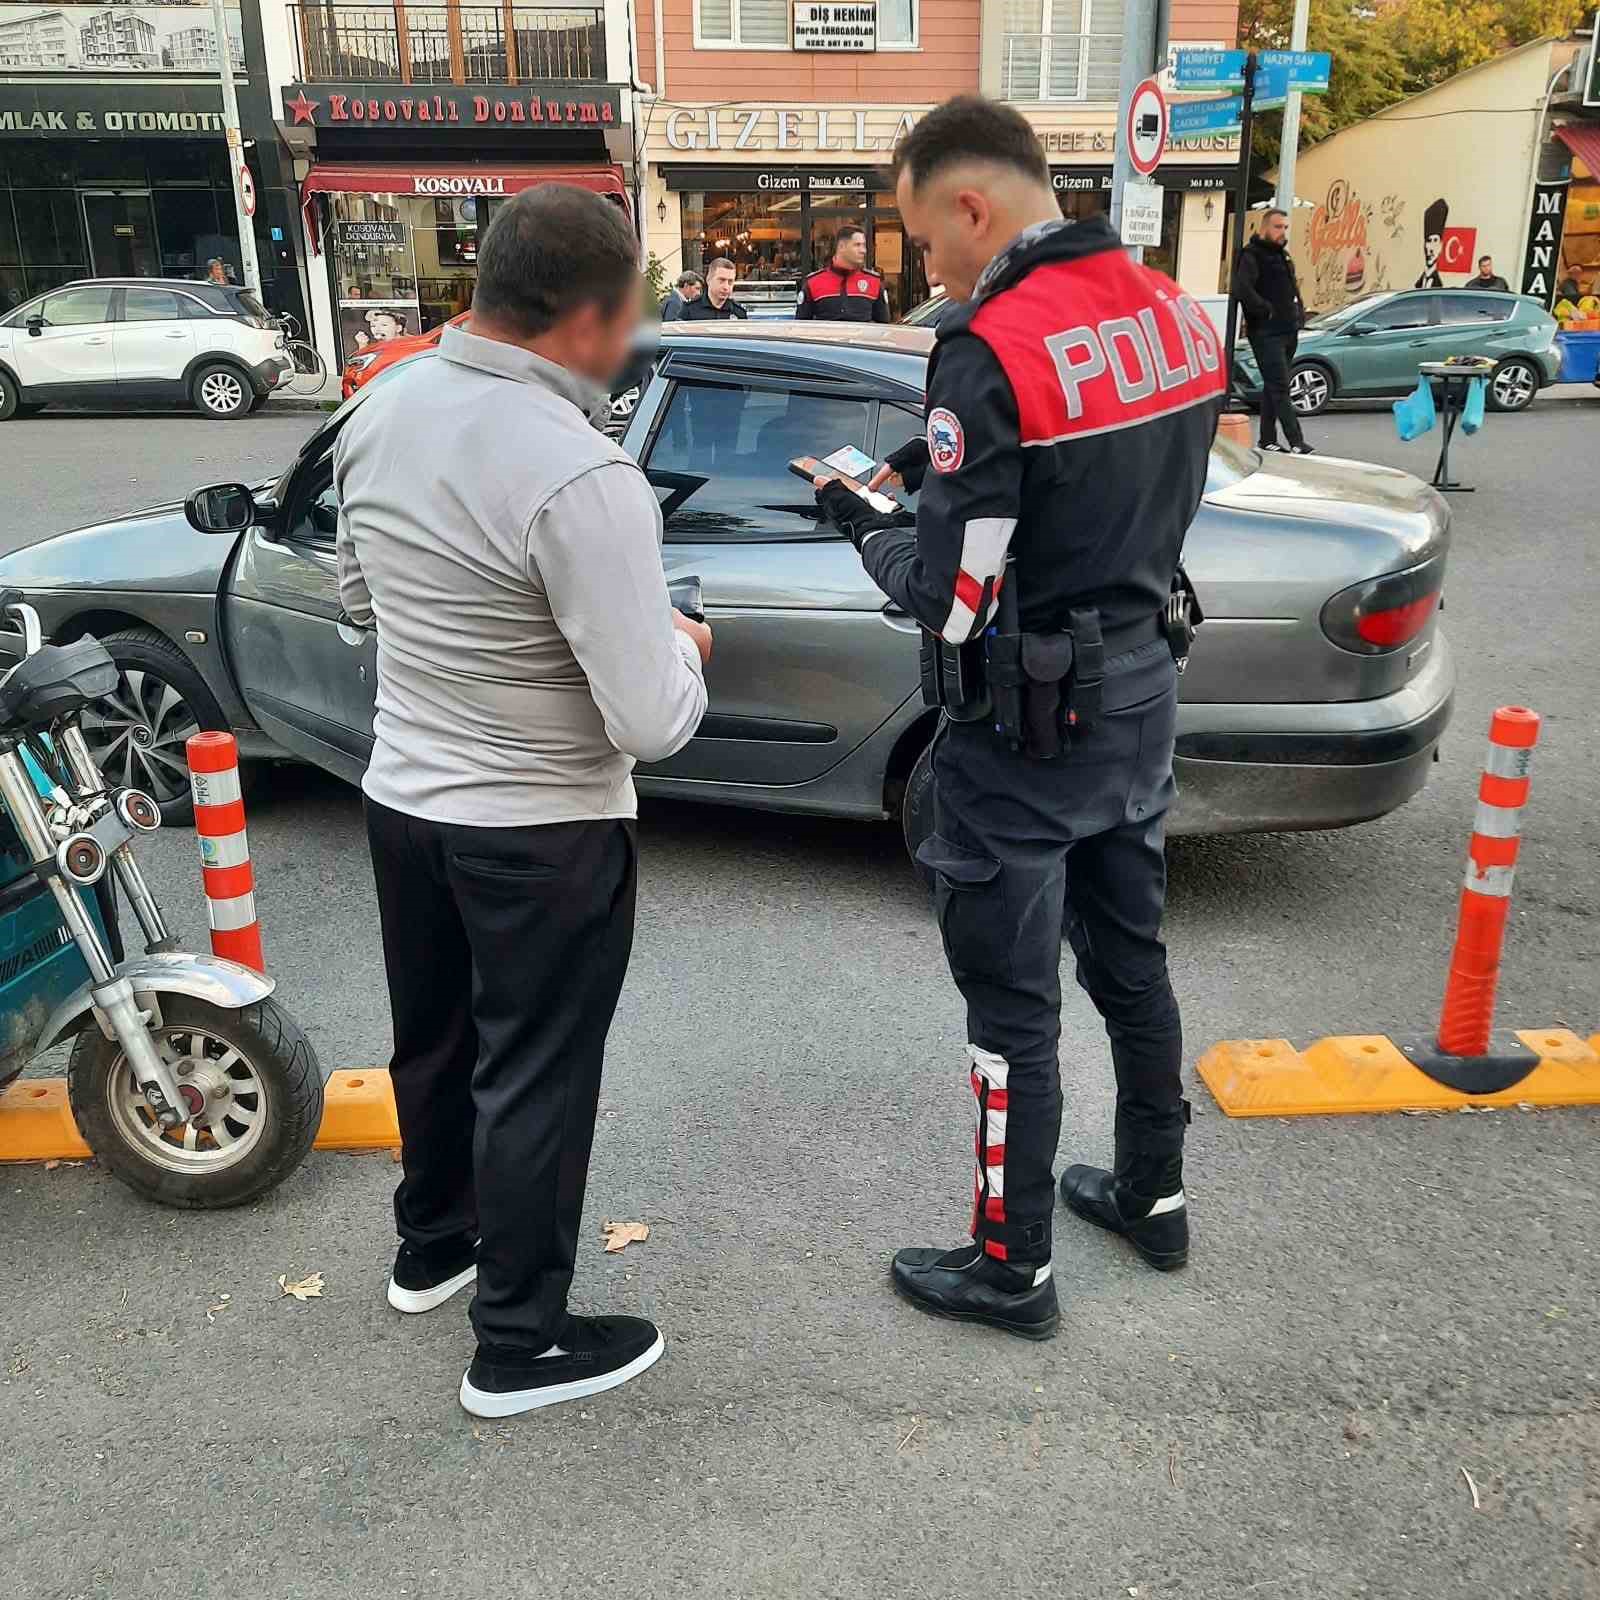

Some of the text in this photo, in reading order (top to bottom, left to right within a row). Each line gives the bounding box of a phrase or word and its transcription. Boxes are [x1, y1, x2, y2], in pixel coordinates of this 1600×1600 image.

[329, 95, 614, 122] Kosovalı Dondurma
[76, 112, 97, 130] &
[413, 177, 505, 194] KOSOVALI
[757, 174, 800, 189] Gizem
[1052, 174, 1094, 189] Gizem
[345, 232, 397, 241] DONDURMA
[347, 224, 393, 233] KOSOVALI
[1043, 288, 1220, 421] POLİS
